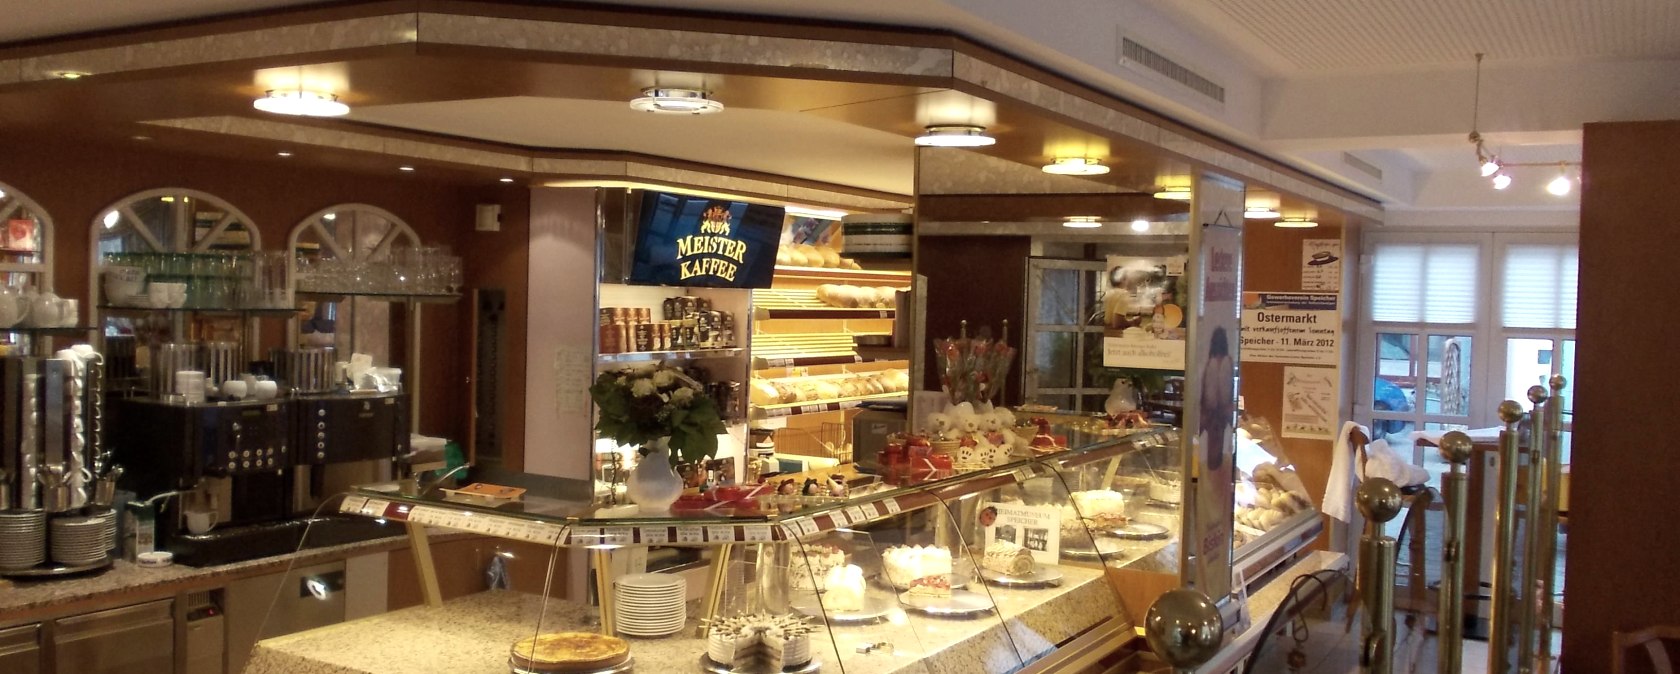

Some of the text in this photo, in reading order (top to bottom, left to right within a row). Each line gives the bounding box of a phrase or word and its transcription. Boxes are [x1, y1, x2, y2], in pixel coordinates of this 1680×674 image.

[676, 234, 747, 264] MEISTER
[680, 258, 738, 282] KAFFEE
[1257, 311, 1317, 324] Ostermarkt
[1240, 336, 1274, 345] Speicher
[1280, 337, 1292, 346] 11.
[1293, 337, 1314, 347] März
[1315, 338, 1335, 347] 2012
